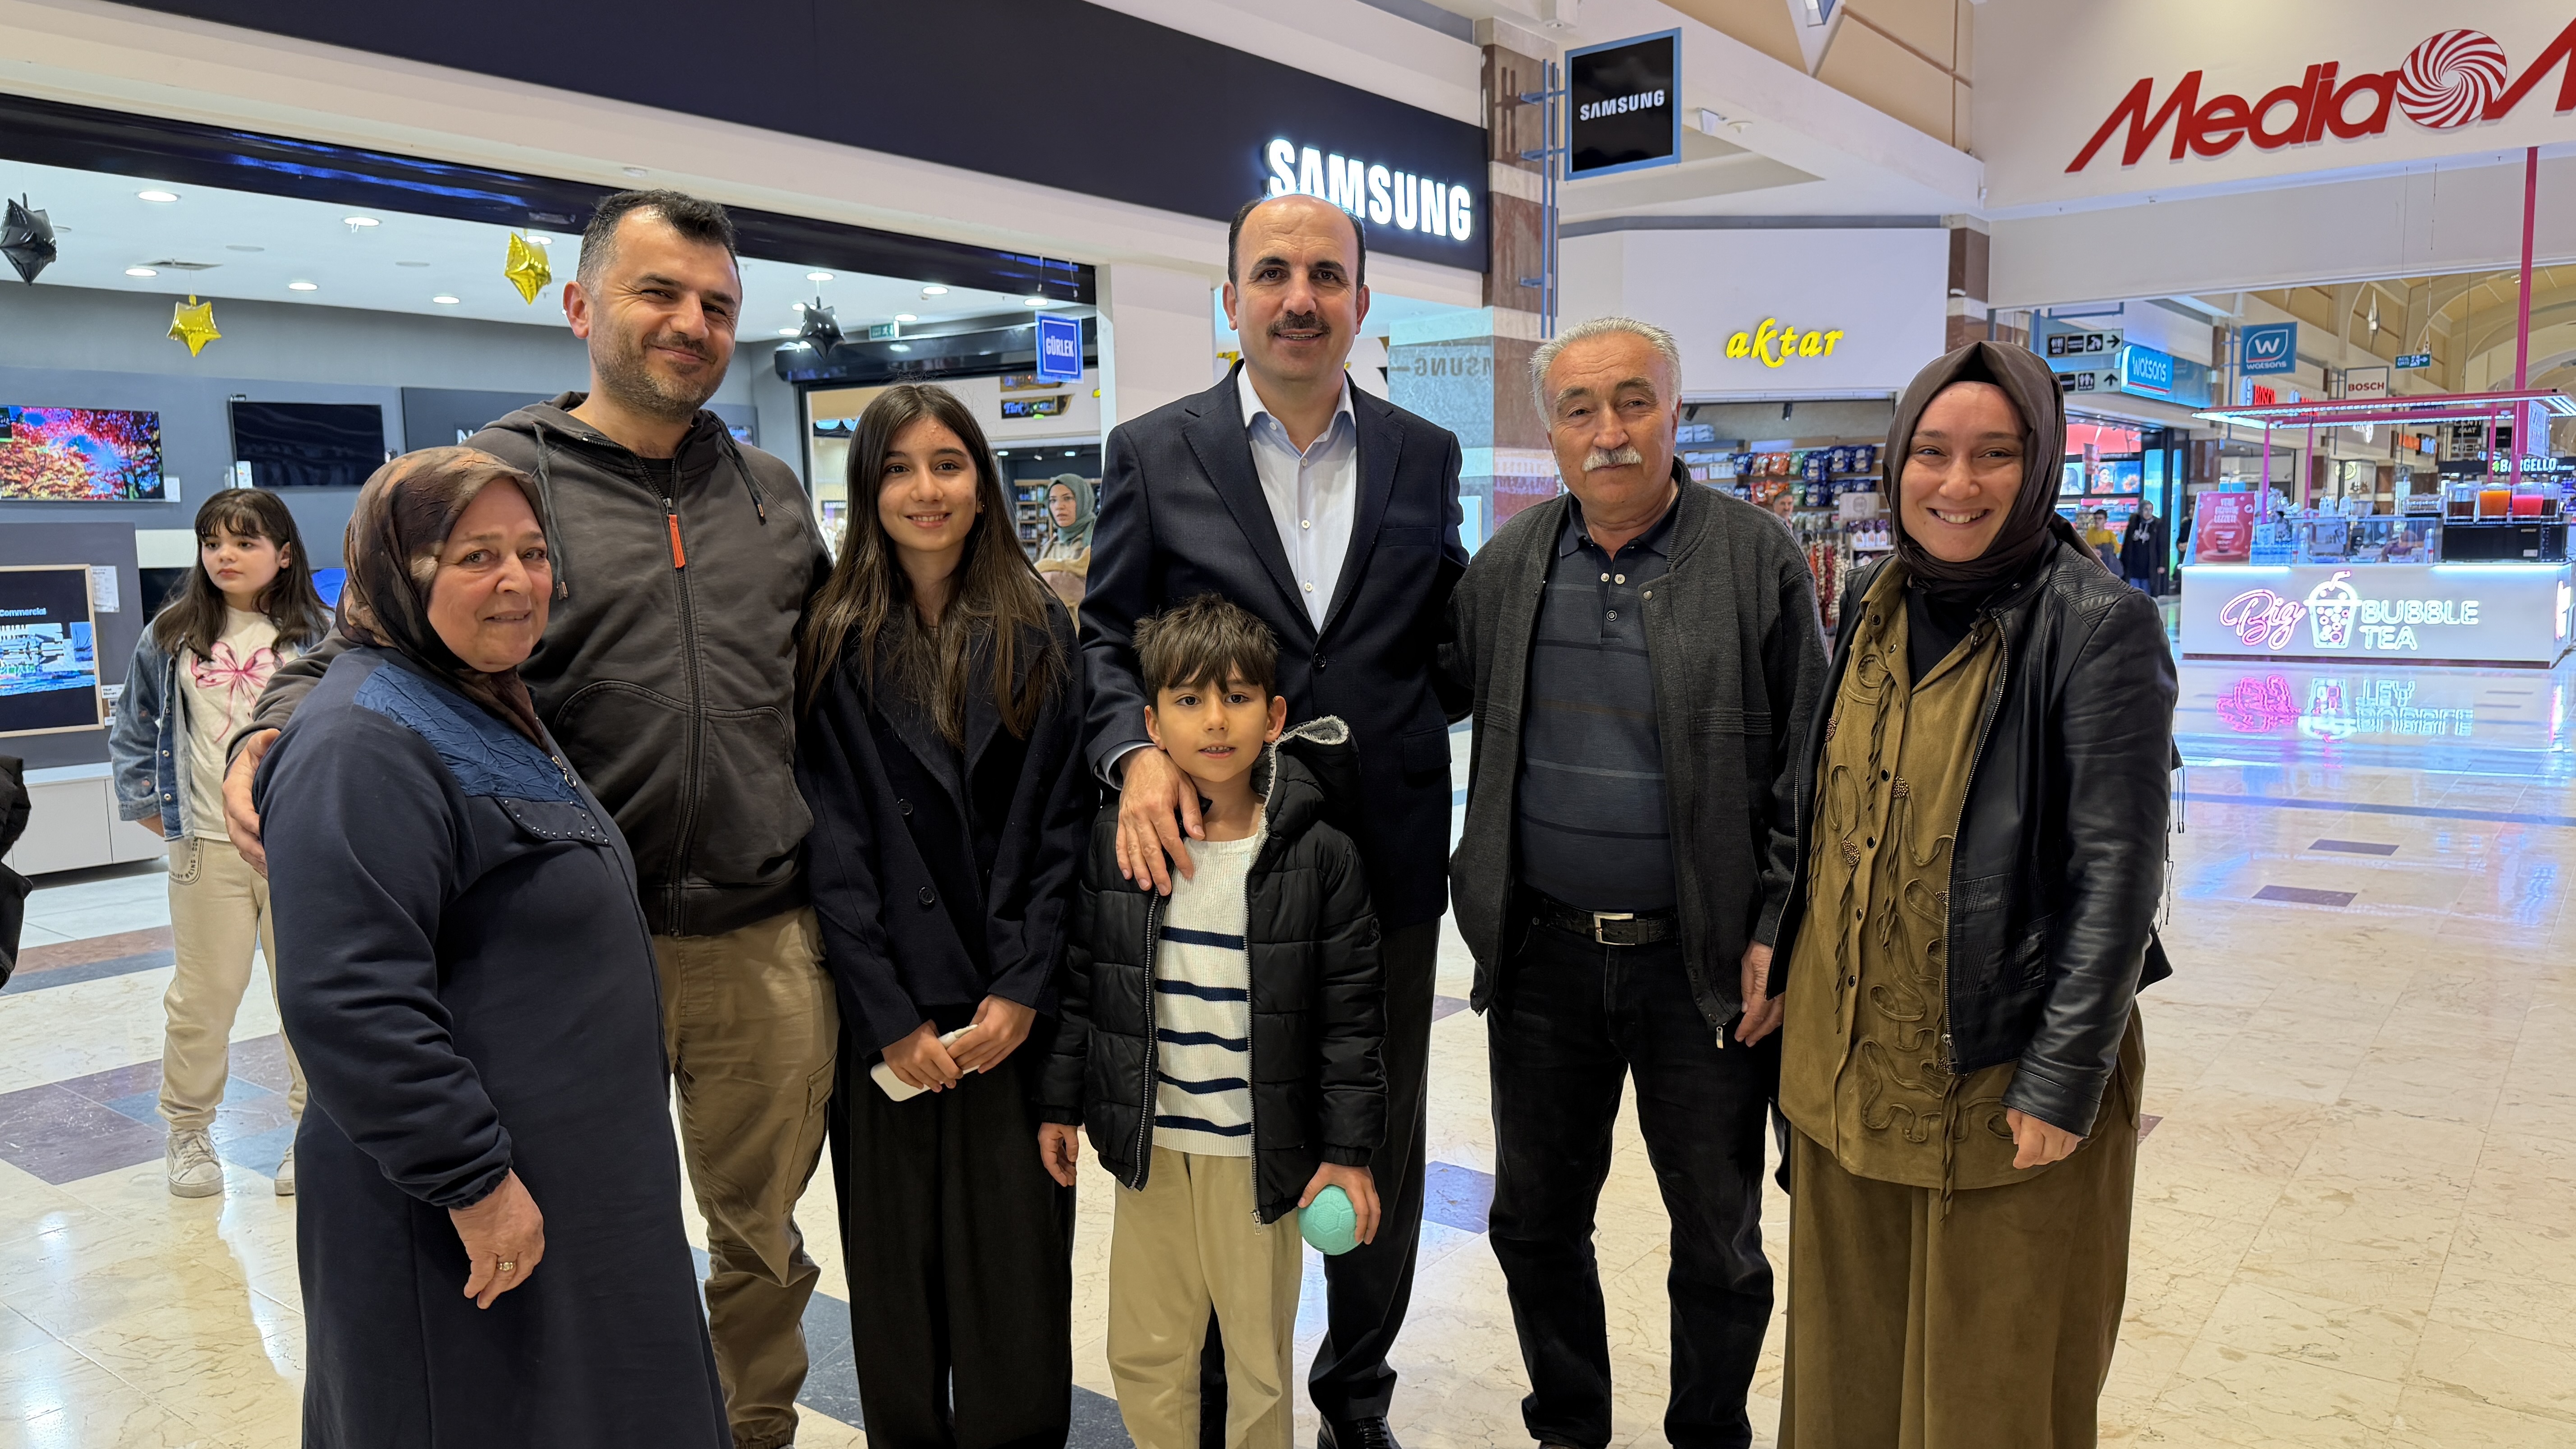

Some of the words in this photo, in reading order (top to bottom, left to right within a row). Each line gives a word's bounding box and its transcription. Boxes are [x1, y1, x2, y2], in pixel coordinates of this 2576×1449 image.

[1579, 89, 1665, 121] SAMSUNG
[2065, 60, 2399, 173] Media
[1266, 138, 1473, 241] SAMSUNG
[1045, 335, 1074, 357] GÜRLEK
[1726, 317, 1844, 368] aktar
[2133, 356, 2167, 382] watsons
[2246, 361, 2287, 370] watsons
[2348, 382, 2385, 391] BOSCH
[0, 607, 47, 617] Commercial
[2220, 589, 2306, 650] Big
[2361, 599, 2479, 625] BUBBLE
[2359, 625, 2418, 651] TEA
